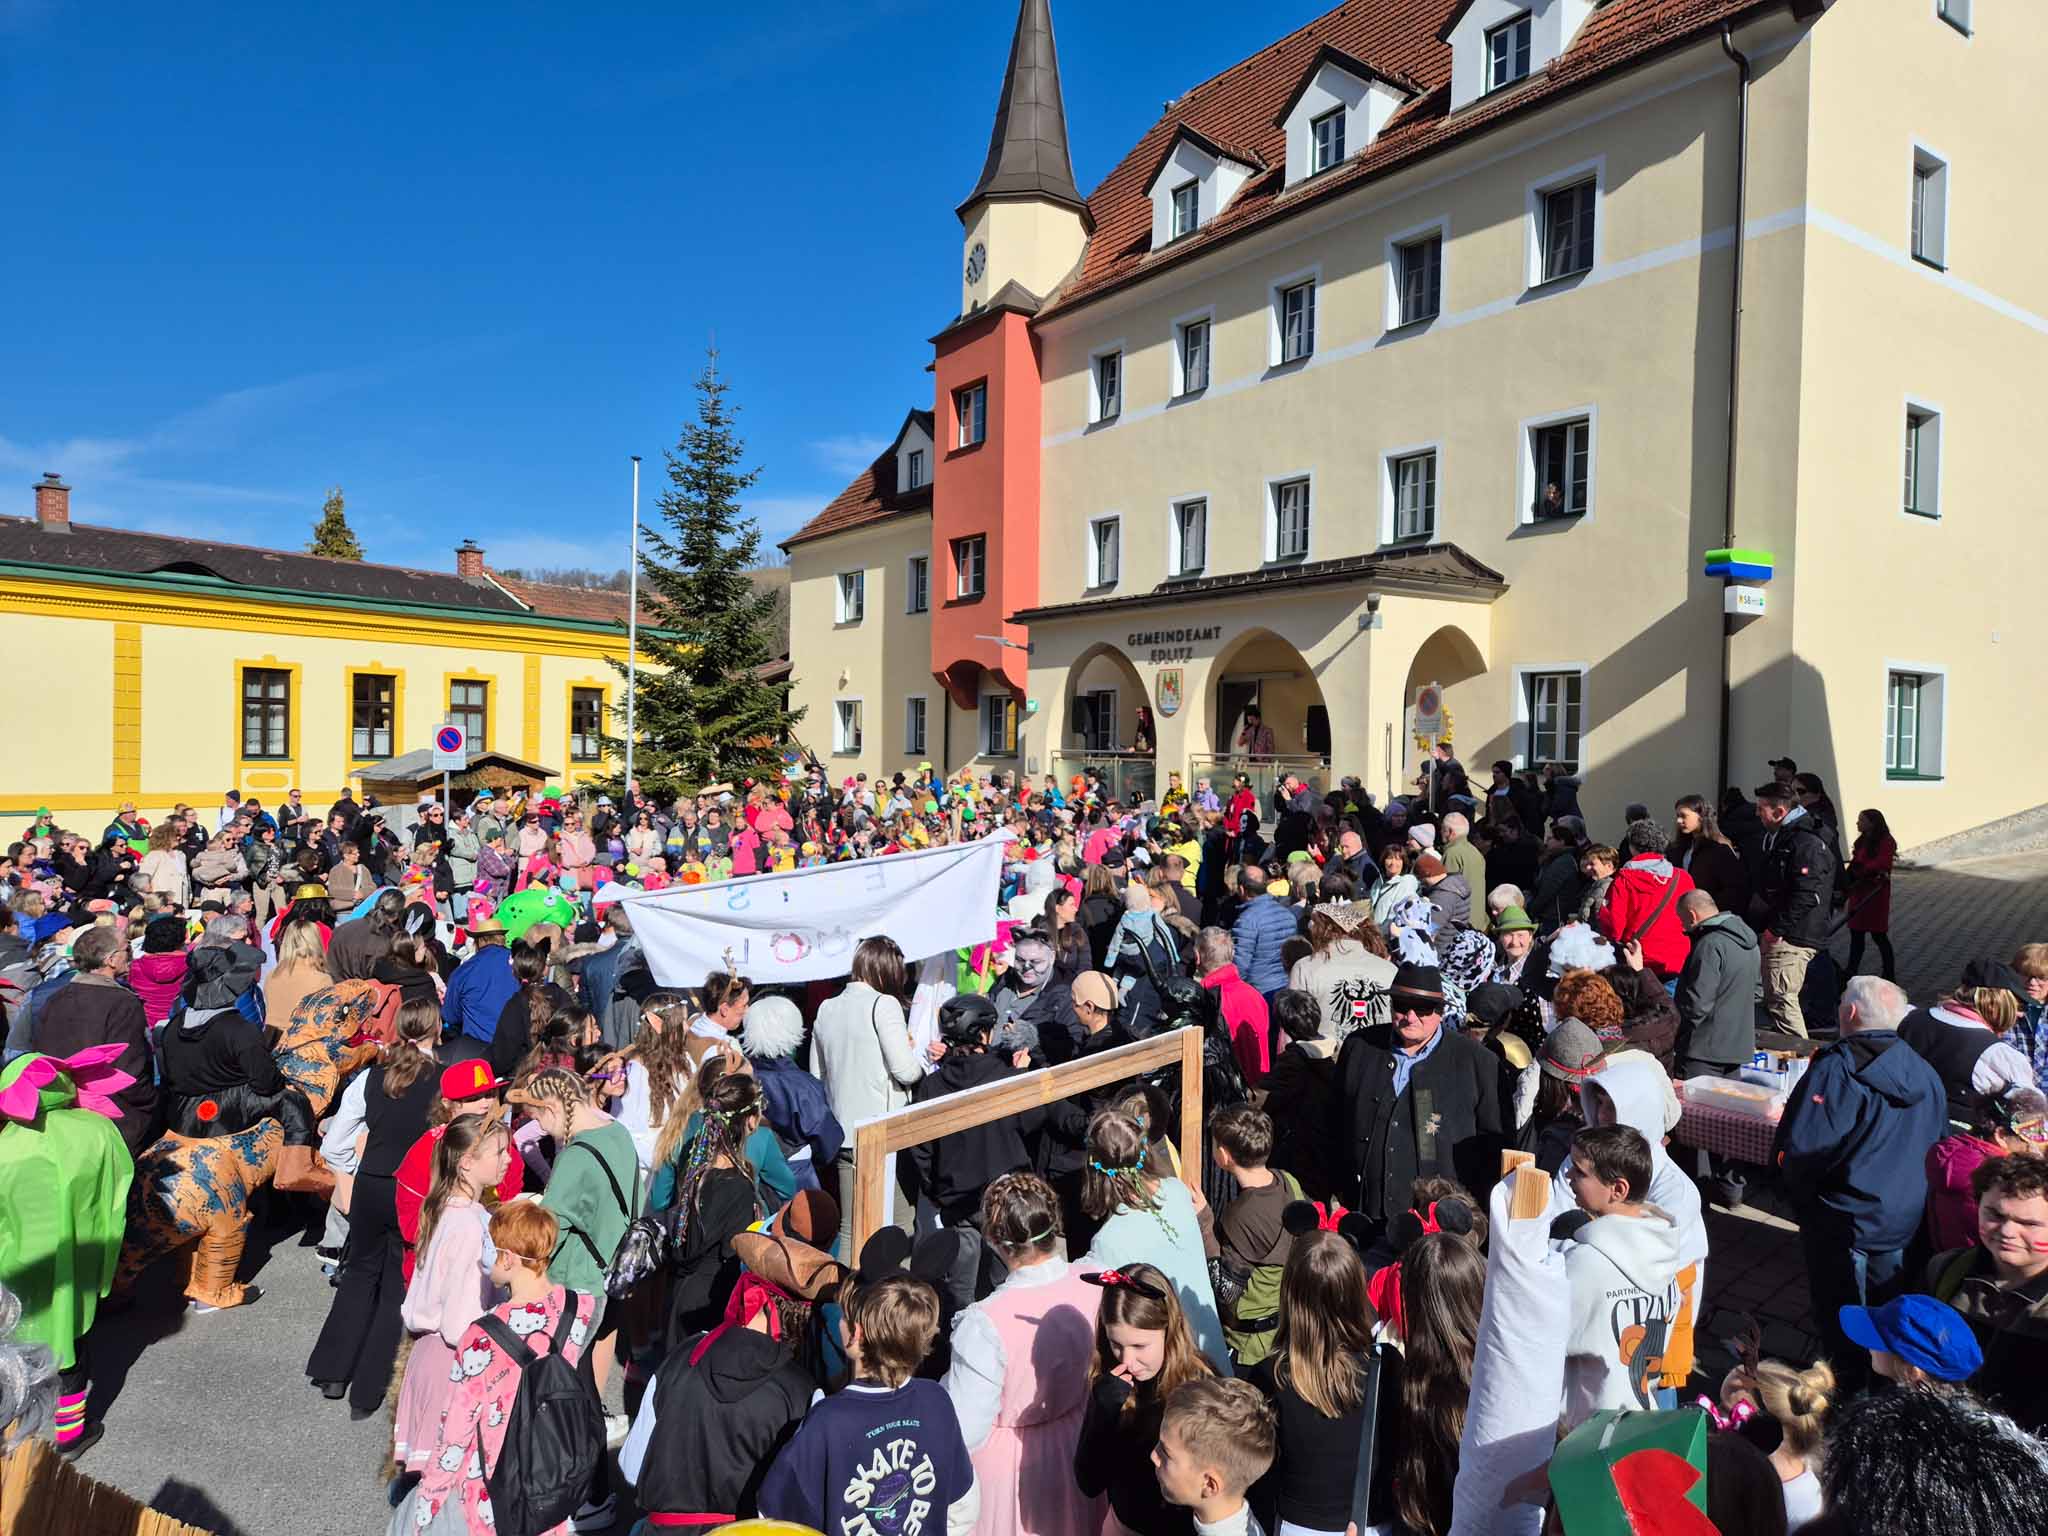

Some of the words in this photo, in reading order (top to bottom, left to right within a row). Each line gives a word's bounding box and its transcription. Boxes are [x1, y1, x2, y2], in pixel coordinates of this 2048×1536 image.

[1127, 626, 1222, 647] GEMEINDEAMT
[1151, 647, 1194, 663] EDLITZ
[1606, 1287, 1641, 1299] PARTNE
[843, 1438, 917, 1508] SKATE
[910, 1453, 936, 1495] TO
